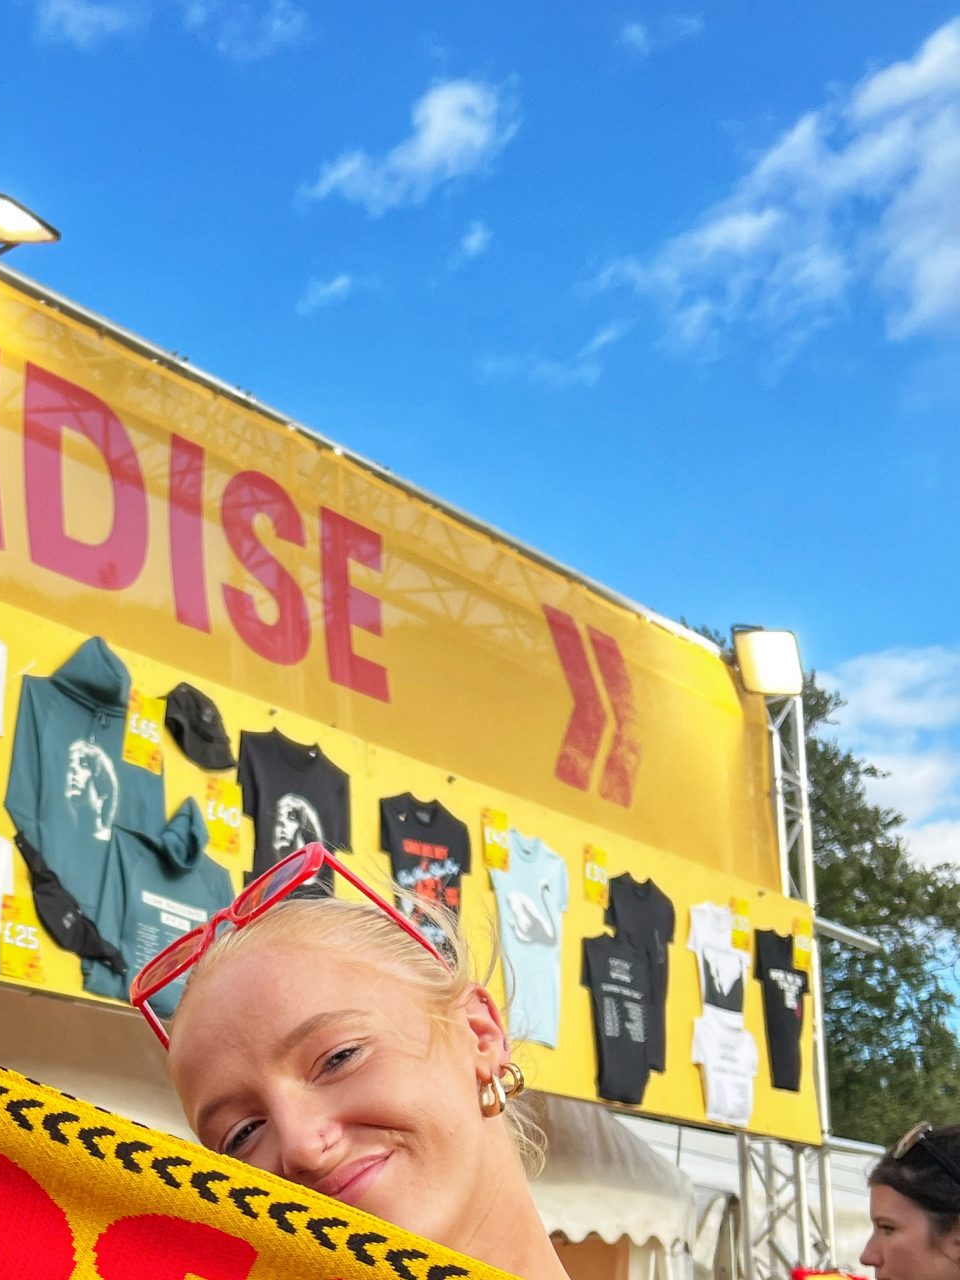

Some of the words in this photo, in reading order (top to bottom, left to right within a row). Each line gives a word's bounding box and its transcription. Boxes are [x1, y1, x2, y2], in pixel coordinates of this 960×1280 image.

[129, 713, 161, 744] £65
[207, 800, 241, 828] £40
[3, 921, 40, 950] £25
